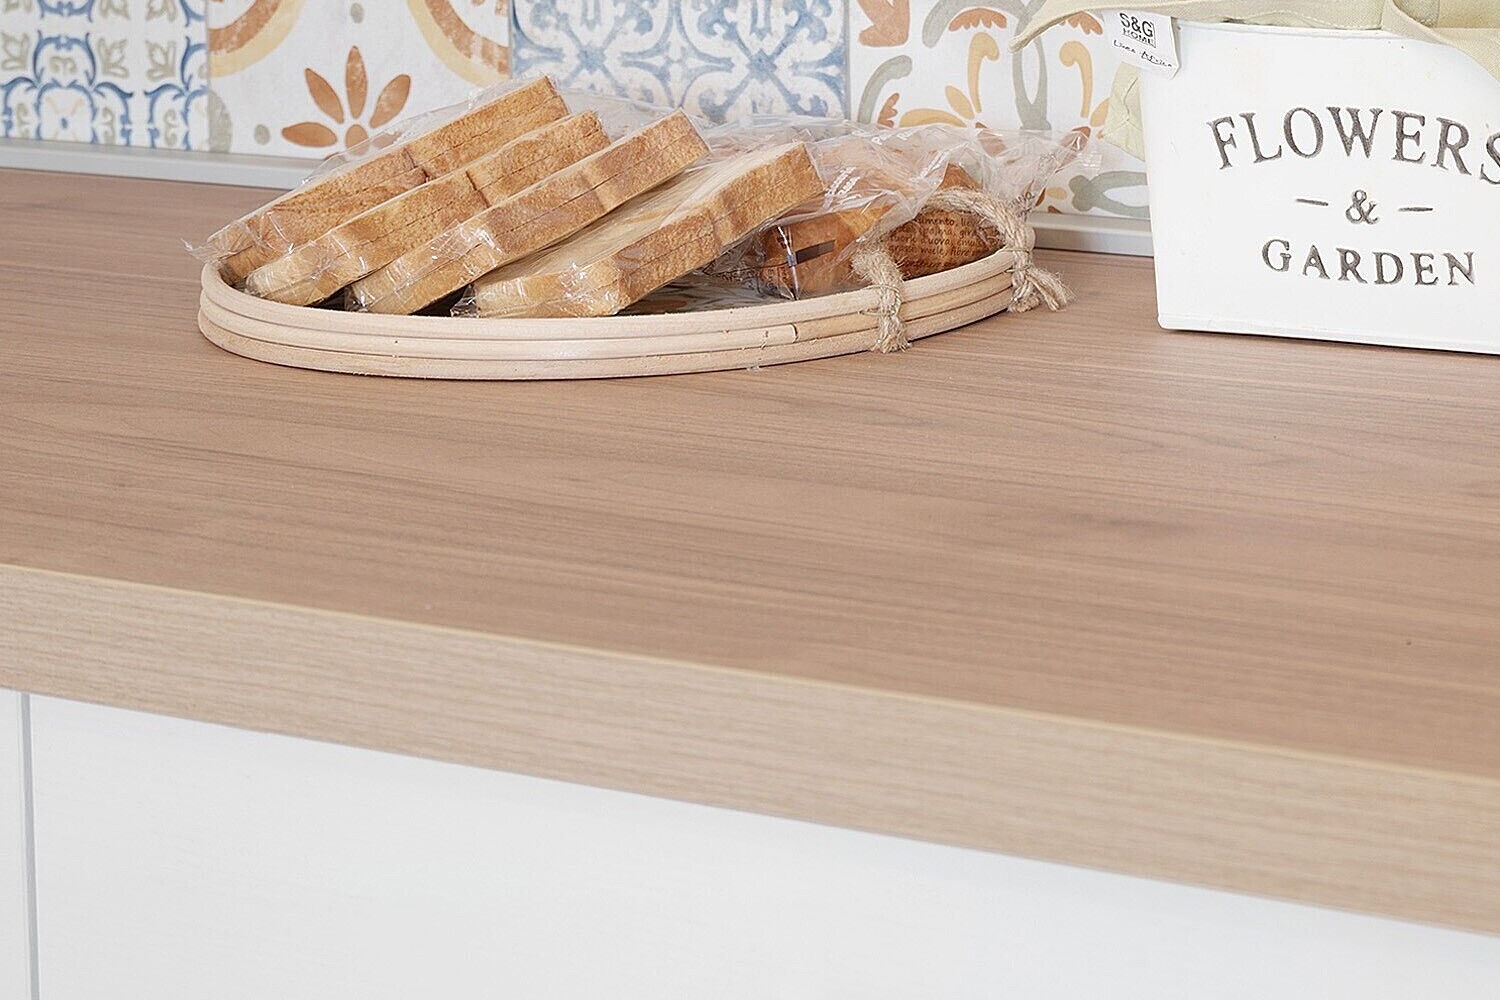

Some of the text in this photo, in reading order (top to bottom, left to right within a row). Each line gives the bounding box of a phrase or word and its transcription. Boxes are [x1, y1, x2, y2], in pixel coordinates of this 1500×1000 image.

[1119, 12, 1154, 38] S&G
[1344, 189, 1380, 225] &
[1261, 238, 1477, 286] GARDEN
